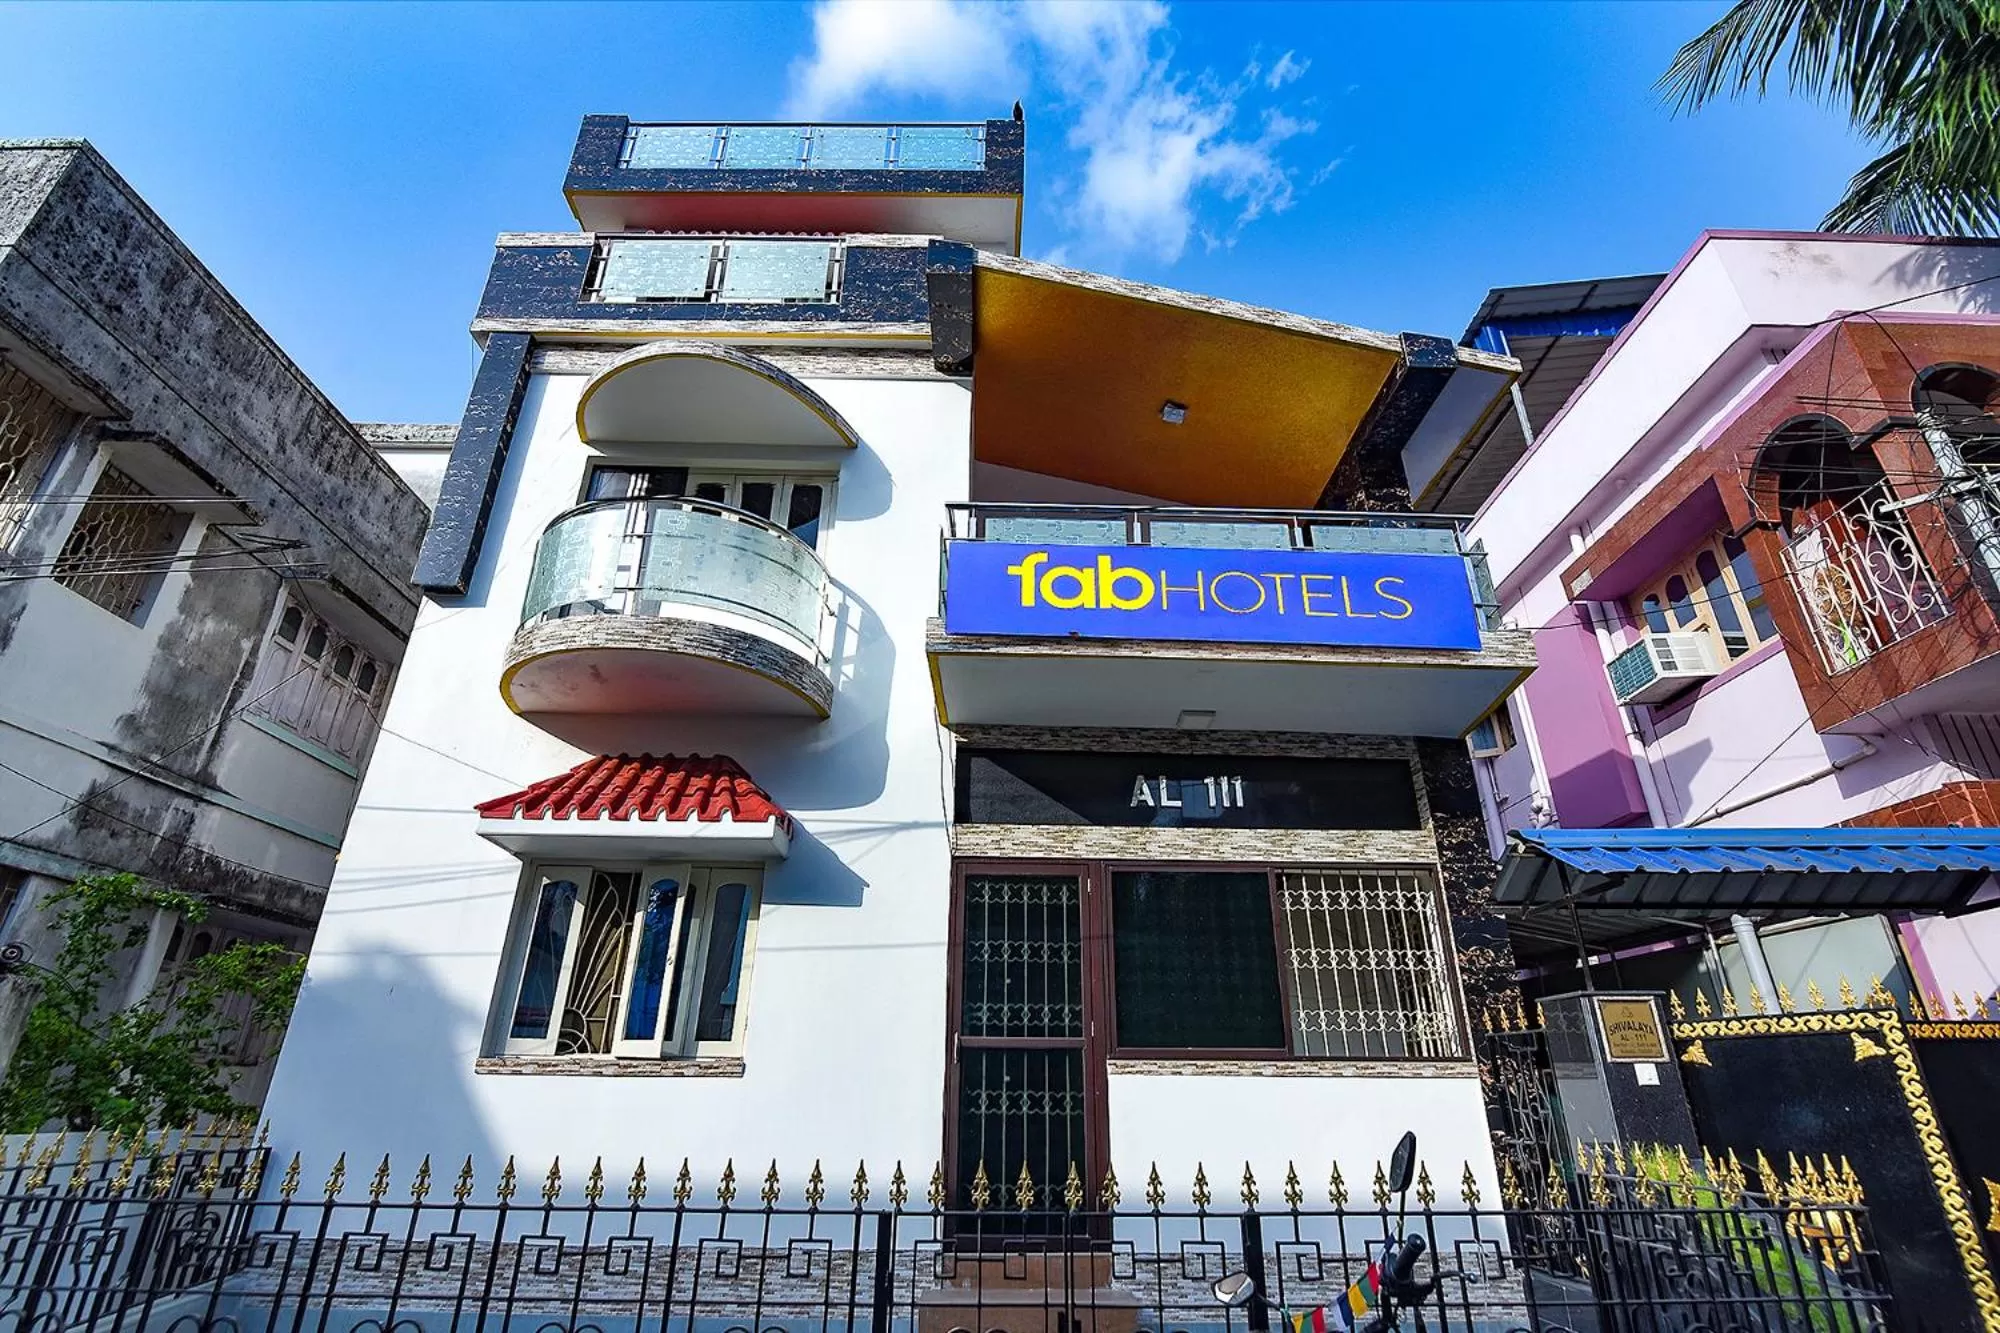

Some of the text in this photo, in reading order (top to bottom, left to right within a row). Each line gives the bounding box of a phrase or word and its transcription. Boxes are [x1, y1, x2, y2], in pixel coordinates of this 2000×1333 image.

[1130, 775, 1244, 808] AL 111
[1609, 1020, 1654, 1036] SHIVALAYA
